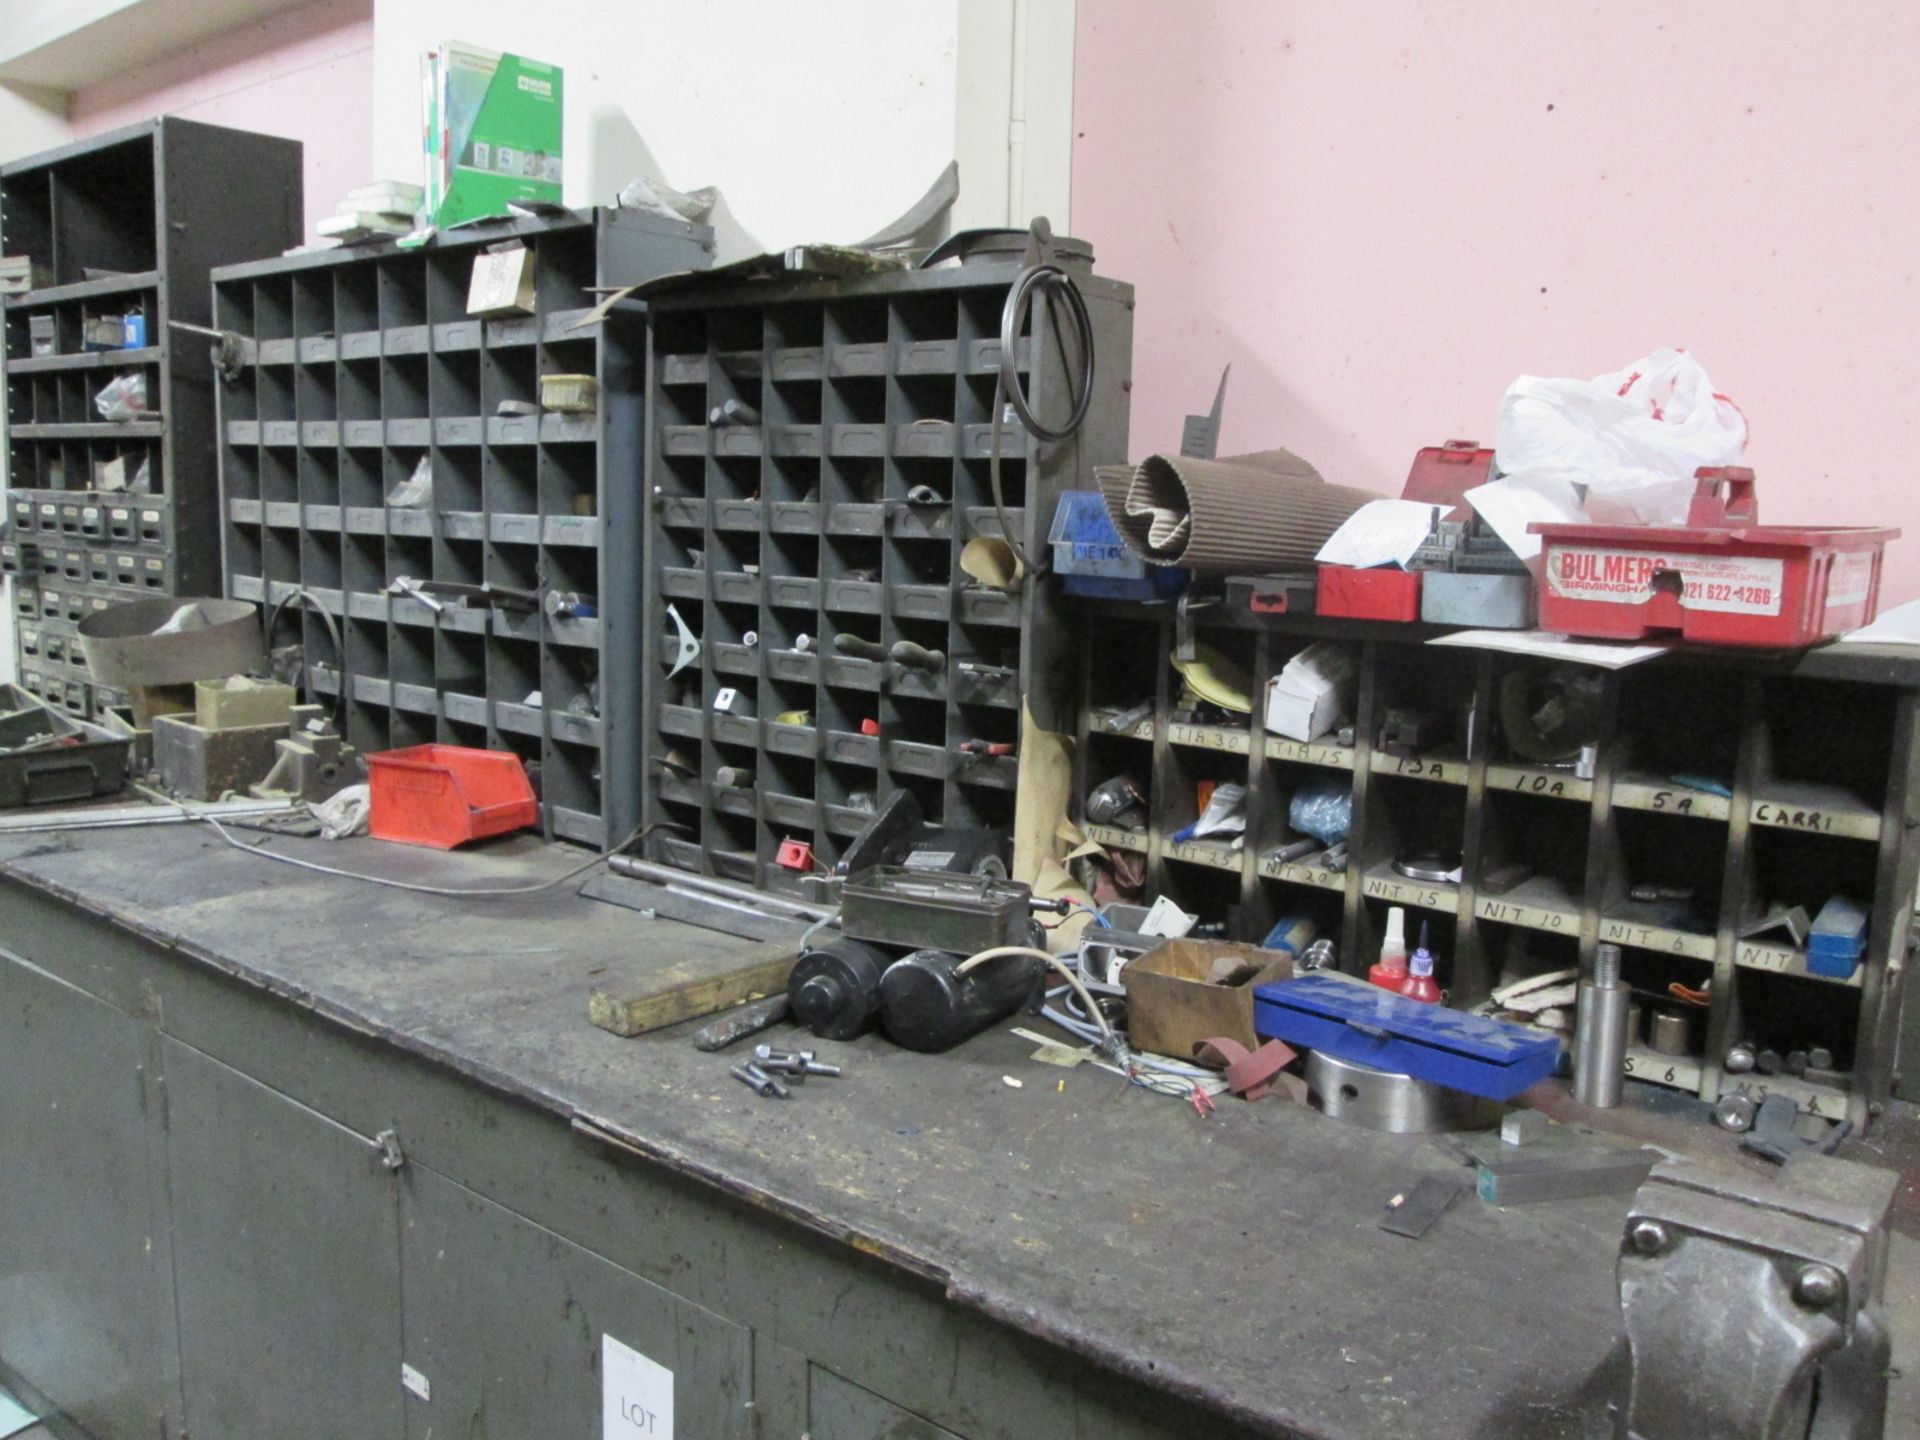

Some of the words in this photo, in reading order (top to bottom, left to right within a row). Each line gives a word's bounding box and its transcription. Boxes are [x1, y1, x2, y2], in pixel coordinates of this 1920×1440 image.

[1561, 580, 1651, 594] BIRMINGHA
[1215, 734, 1239, 749] 30
[1318, 750, 1343, 764] 15
[1756, 805, 1831, 831] CARRI
[1088, 826, 1112, 841] NIT
[1119, 835, 1137, 847] 30
[1171, 843, 1197, 860] NIT
[1208, 849, 1230, 866] 25
[1266, 862, 1292, 878] NIT
[1306, 871, 1327, 883] 20
[1369, 881, 1402, 898] NIT
[1417, 891, 1439, 905] 15
[1484, 902, 1525, 921] NIT
[1540, 914, 1561, 928] 10
[1609, 925, 1653, 944] NIT
[1673, 936, 1684, 951] 6
[1743, 947, 1789, 968] NIT
[1664, 1067, 1676, 1083] 6
[621, 1395, 657, 1435] LOT
